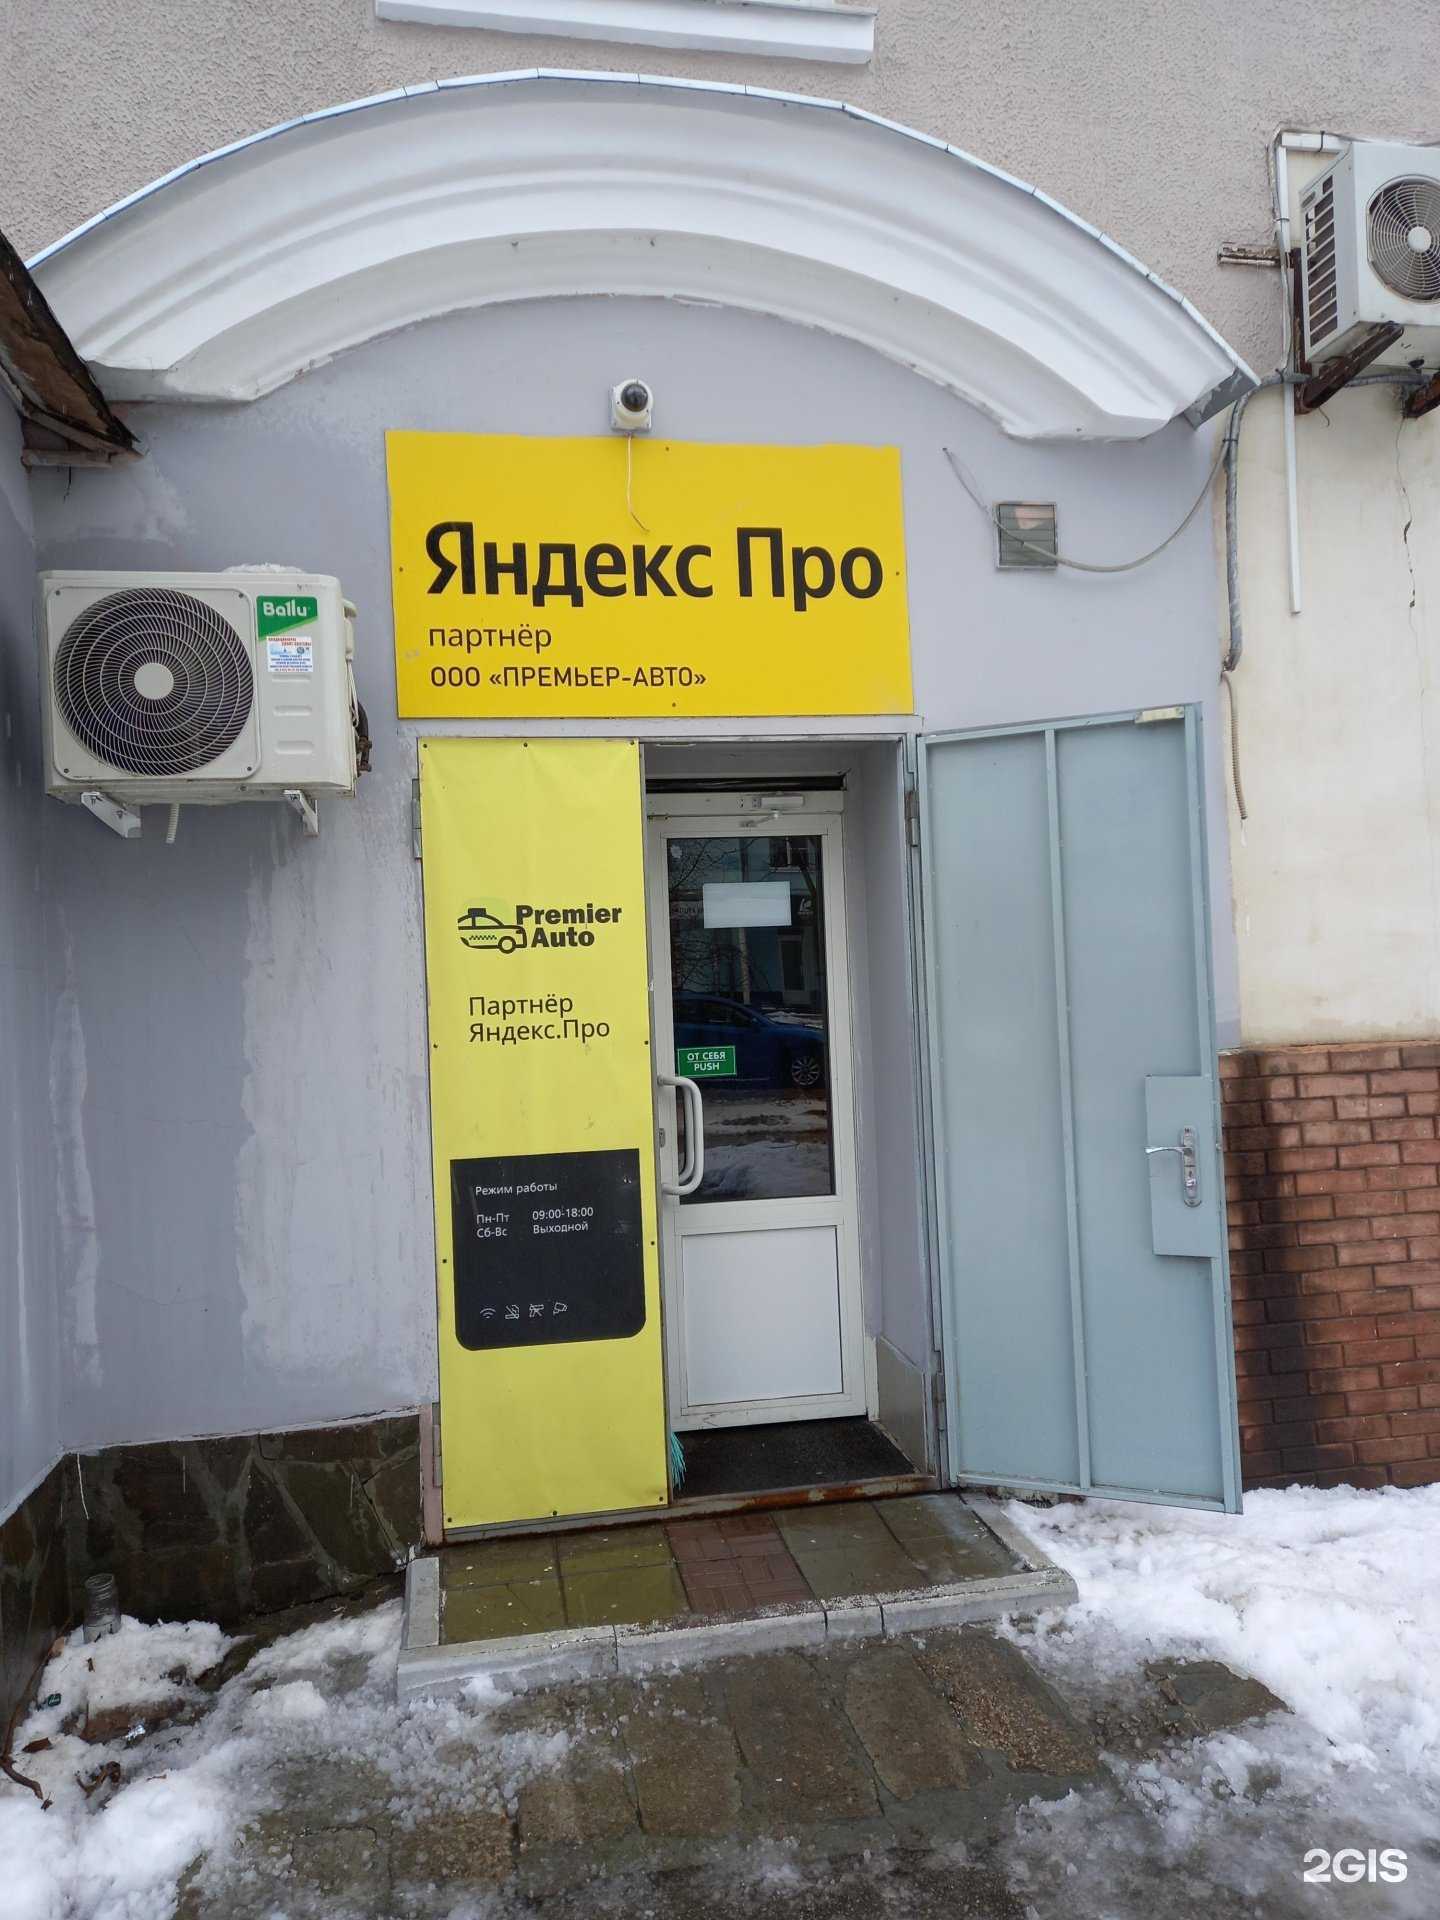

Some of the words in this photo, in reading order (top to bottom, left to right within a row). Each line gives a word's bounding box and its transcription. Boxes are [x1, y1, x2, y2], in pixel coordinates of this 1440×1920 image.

[425, 521, 714, 607] Яндекс
[736, 526, 883, 612] Про
[263, 599, 307, 617] Ballu
[428, 623, 552, 653] партнёр
[430, 667, 481, 687] ООО
[488, 665, 707, 688] «ПРЕМЬЕР-АВТО»
[515, 903, 622, 925] Premier
[531, 927, 595, 948] Auto
[469, 993, 573, 1020] Партнёр
[469, 1019, 610, 1045] Яндекс.Про
[687, 1052, 699, 1061] ОТ
[702, 1051, 726, 1060] СЕБЯ
[694, 1062, 720, 1071] PUSH
[475, 1185, 513, 1196] Режим
[516, 1182, 558, 1195] работы
[476, 1212, 510, 1225] Пн-Пт
[532, 1206, 594, 1220] 09:00-18:00
[476, 1228, 509, 1238] Сб-Вс
[533, 1221, 589, 1234] Выходной
